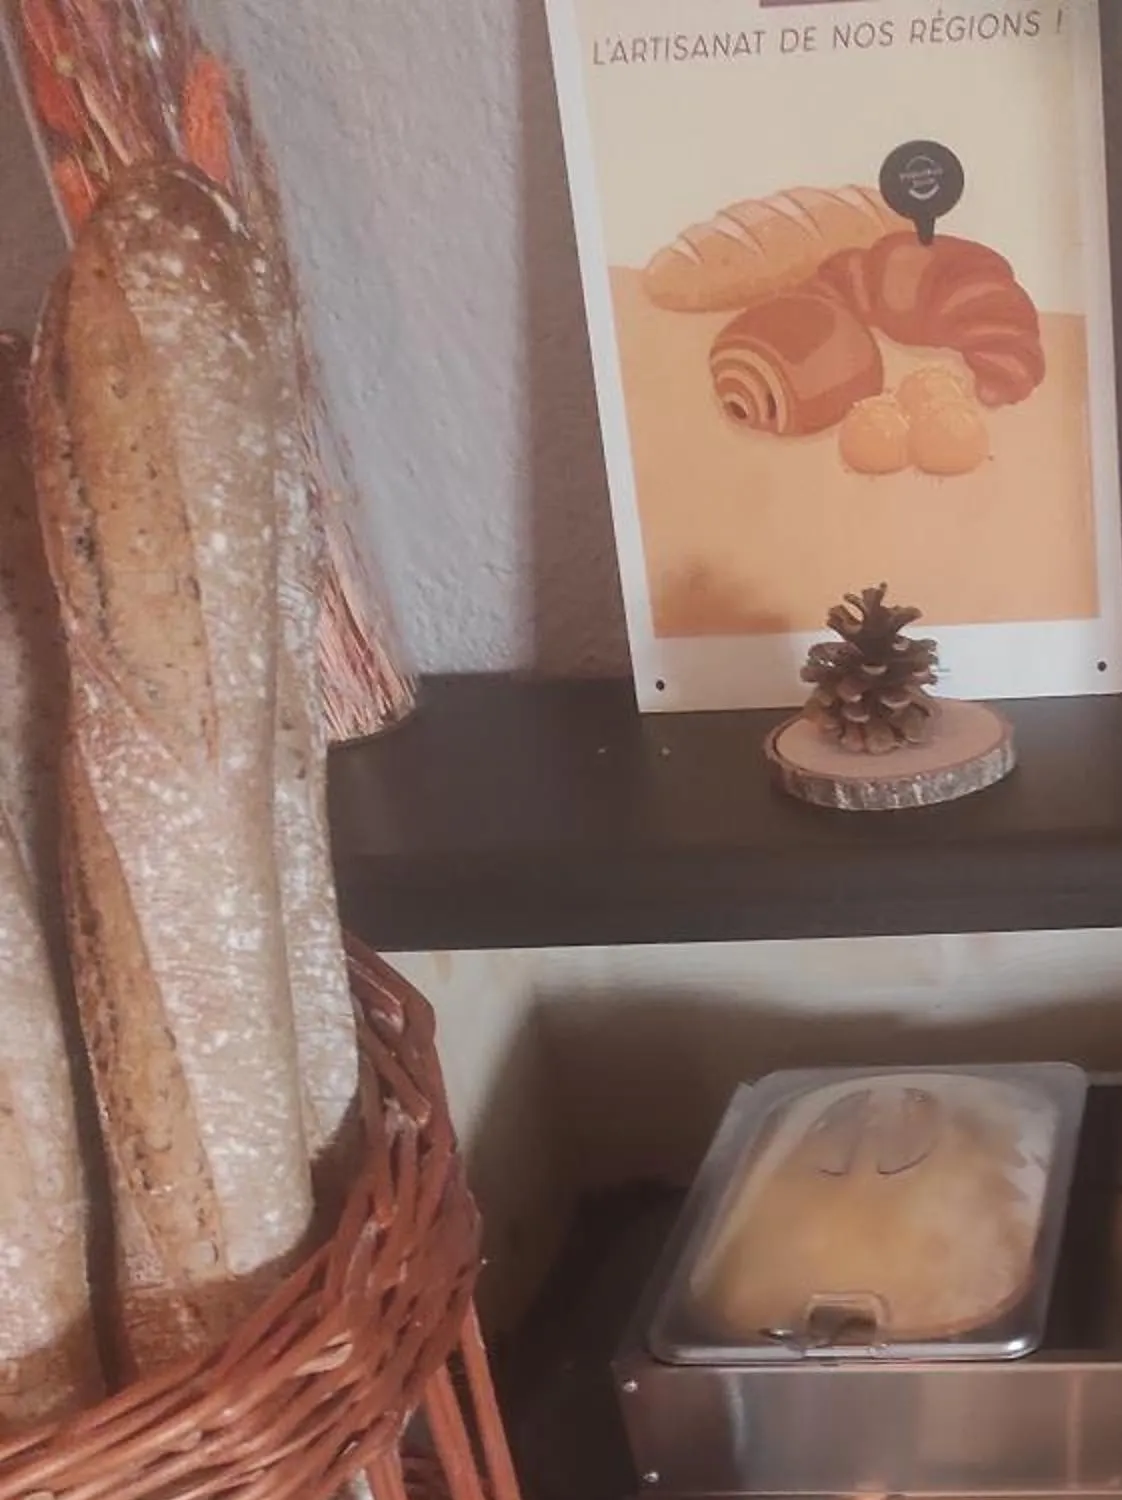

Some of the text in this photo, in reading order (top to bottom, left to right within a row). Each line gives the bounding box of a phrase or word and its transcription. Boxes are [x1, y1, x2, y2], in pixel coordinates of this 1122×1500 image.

[592, 30, 766, 65] L'ARTISANAT
[780, 27, 817, 52] DE
[832, 20, 894, 48] NOS
[910, 8, 1040, 44] RÉGIONS
